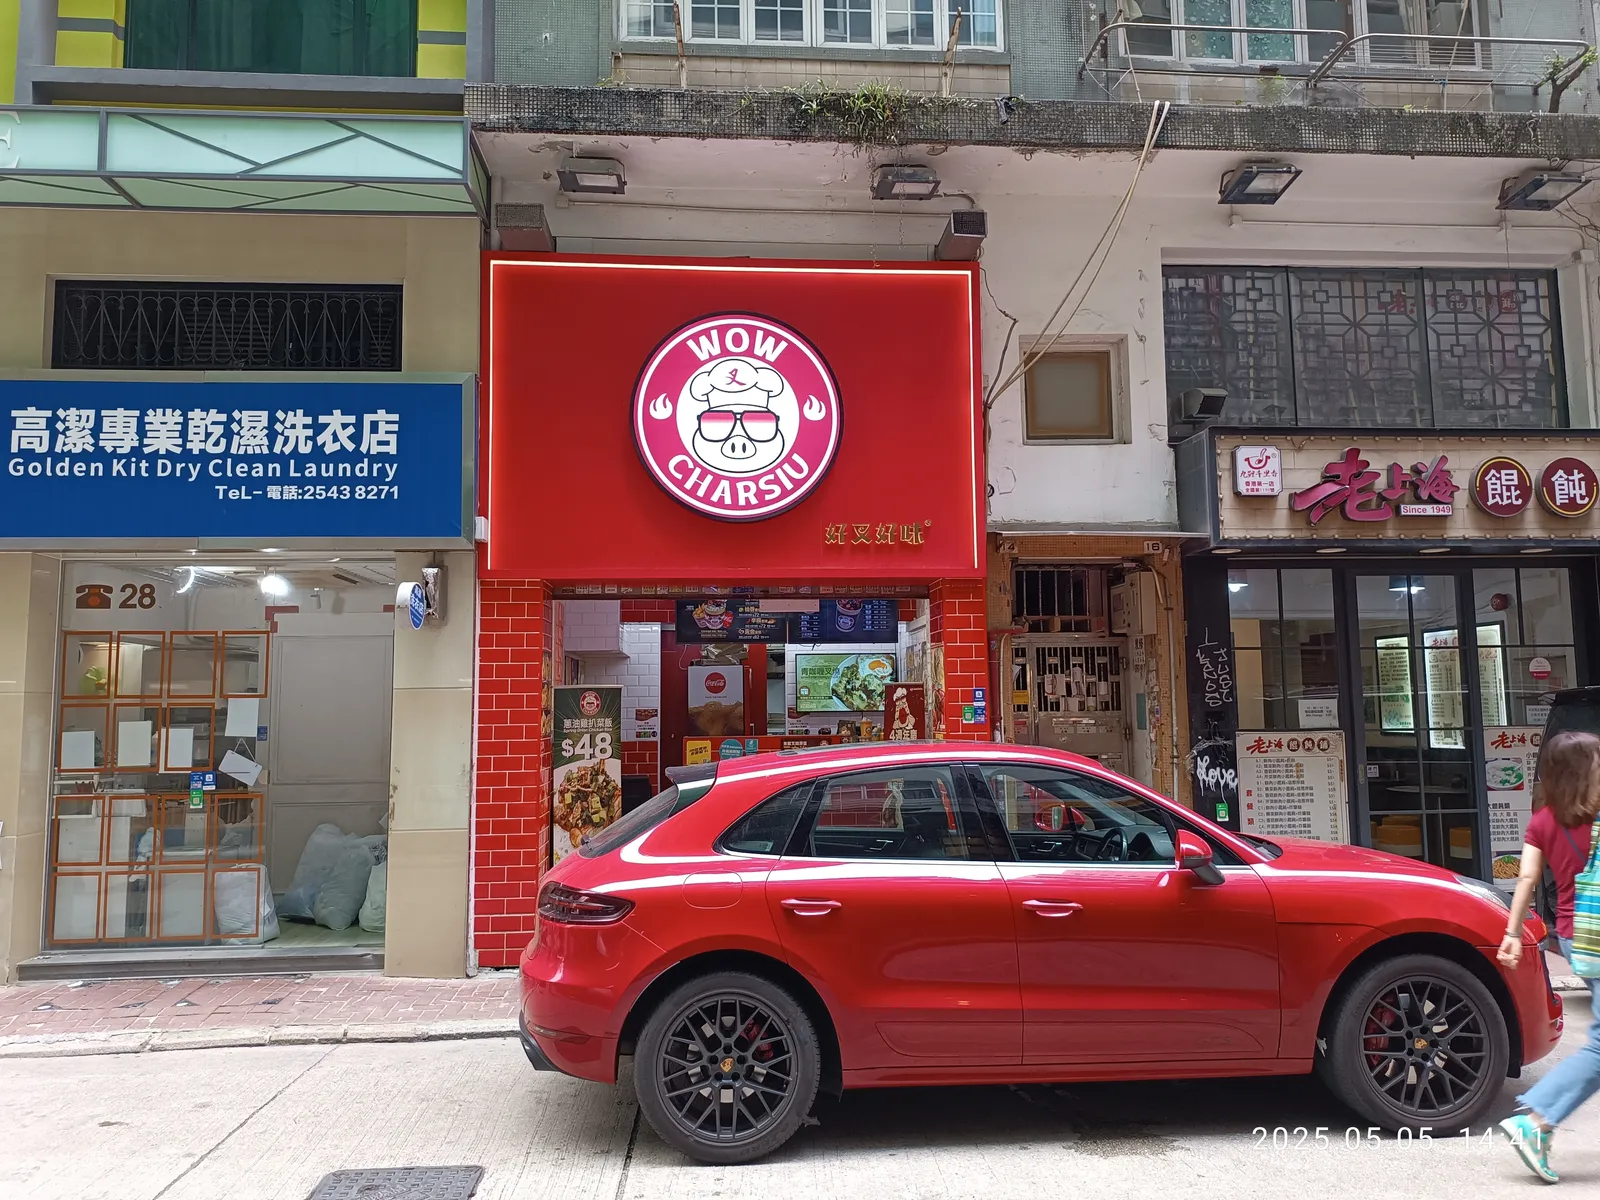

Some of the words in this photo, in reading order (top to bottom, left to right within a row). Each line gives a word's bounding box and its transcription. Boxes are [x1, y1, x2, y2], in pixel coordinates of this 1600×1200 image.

[686, 327, 789, 363] WOW
[10, 406, 400, 455] 高潔專業乾濕洗衣店
[8, 457, 104, 477] Golden
[112, 457, 150, 477] Kit
[157, 458, 202, 482] Dry
[208, 457, 281, 478] Clean
[289, 457, 399, 482] Laundry
[668, 453, 809, 507] CHARSIU
[354, 485, 399, 500] 8271
[1289, 447, 1461, 526] 老上海
[1402, 505, 1427, 514] Since
[1430, 505, 1451, 513] 1949
[825, 522, 925, 544] 好叉好味
[118, 583, 156, 610] 28
[561, 732, 613, 760] $48
[1246, 736, 1284, 754] 老上海
[1491, 731, 1527, 749] 老上海
